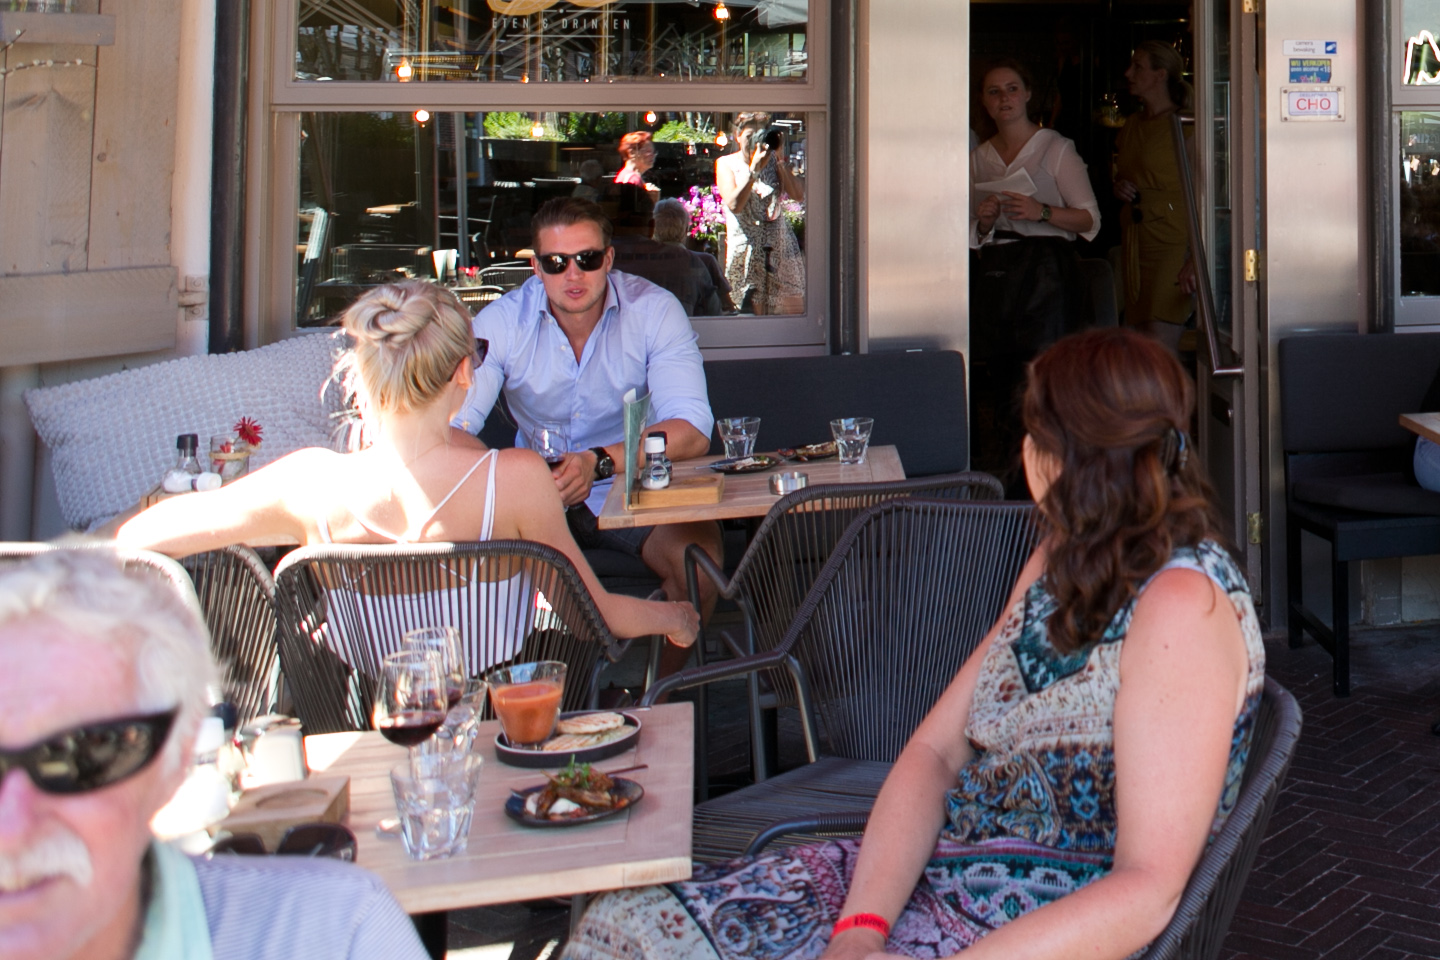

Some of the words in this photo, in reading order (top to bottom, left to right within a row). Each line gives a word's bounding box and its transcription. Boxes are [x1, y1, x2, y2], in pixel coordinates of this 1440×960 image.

[492, 18, 529, 29] ETEN
[542, 19, 549, 29] &
[562, 18, 630, 30] DRINKEN
[1296, 98, 1331, 110] CHO
